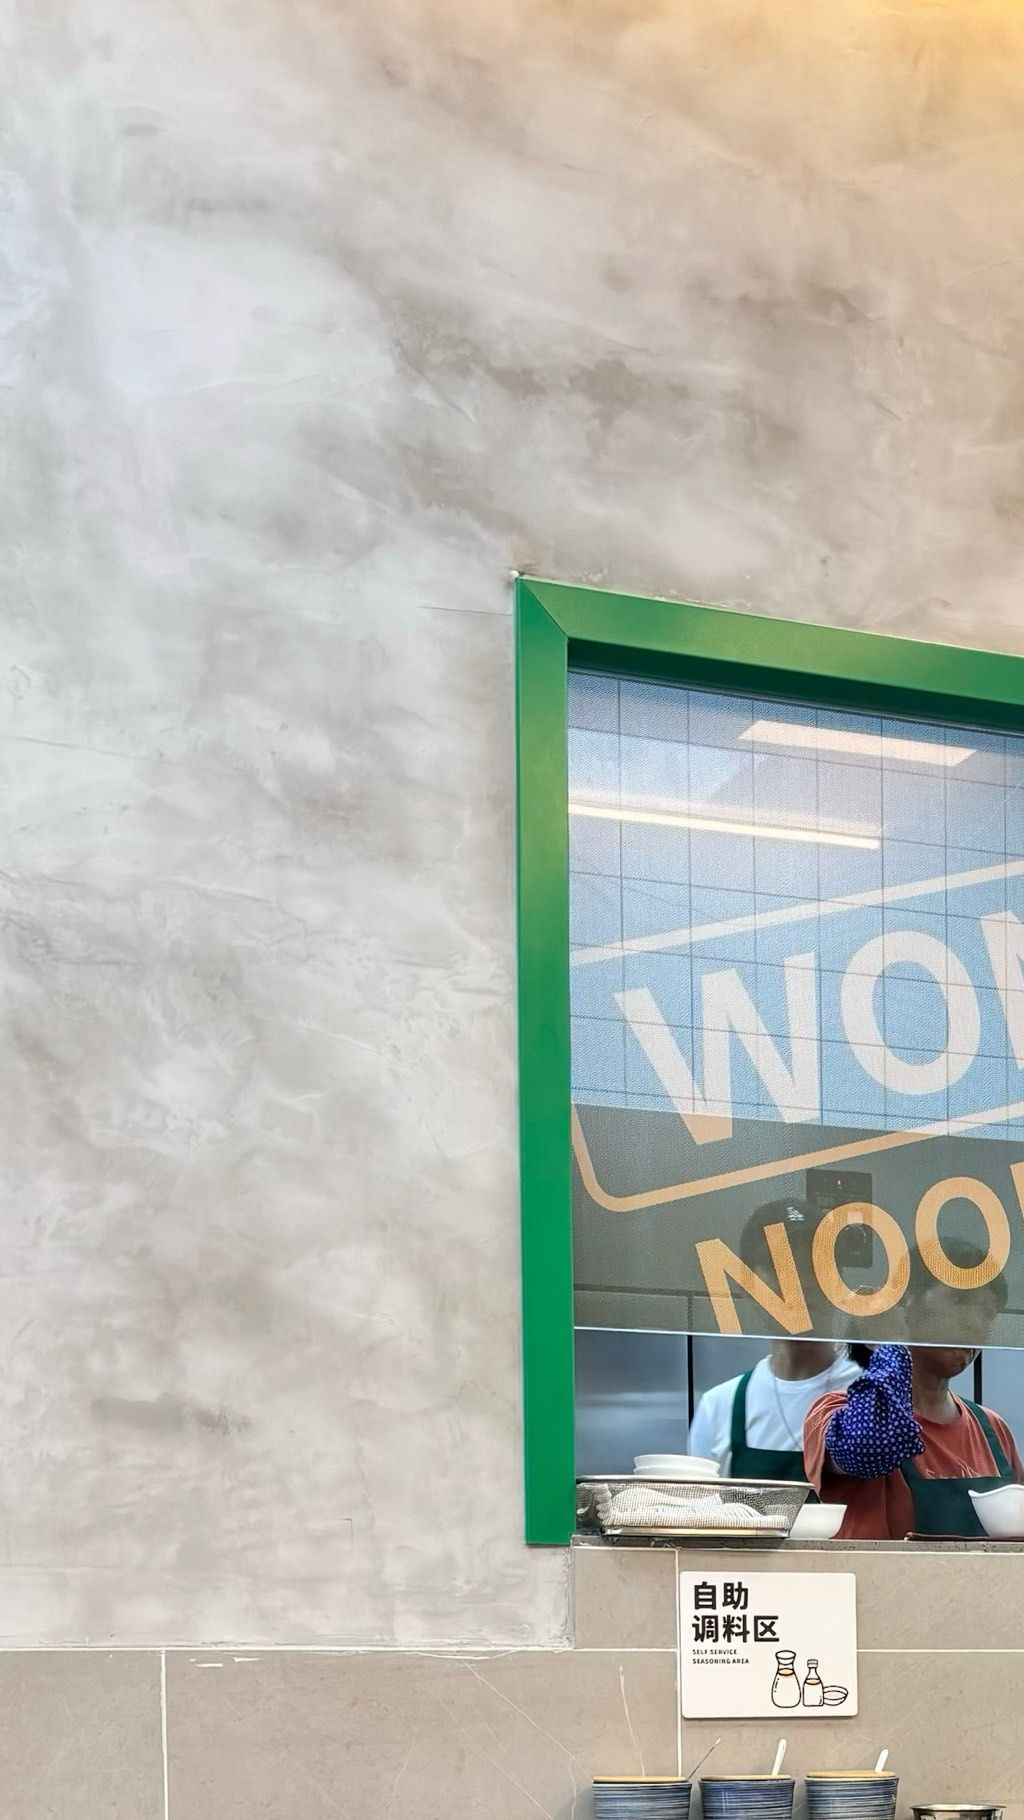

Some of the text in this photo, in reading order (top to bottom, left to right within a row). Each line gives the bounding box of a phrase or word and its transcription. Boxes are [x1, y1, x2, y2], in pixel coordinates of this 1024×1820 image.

[693, 1581, 749, 1611] 自助
[692, 1614, 780, 1643] 调料区
